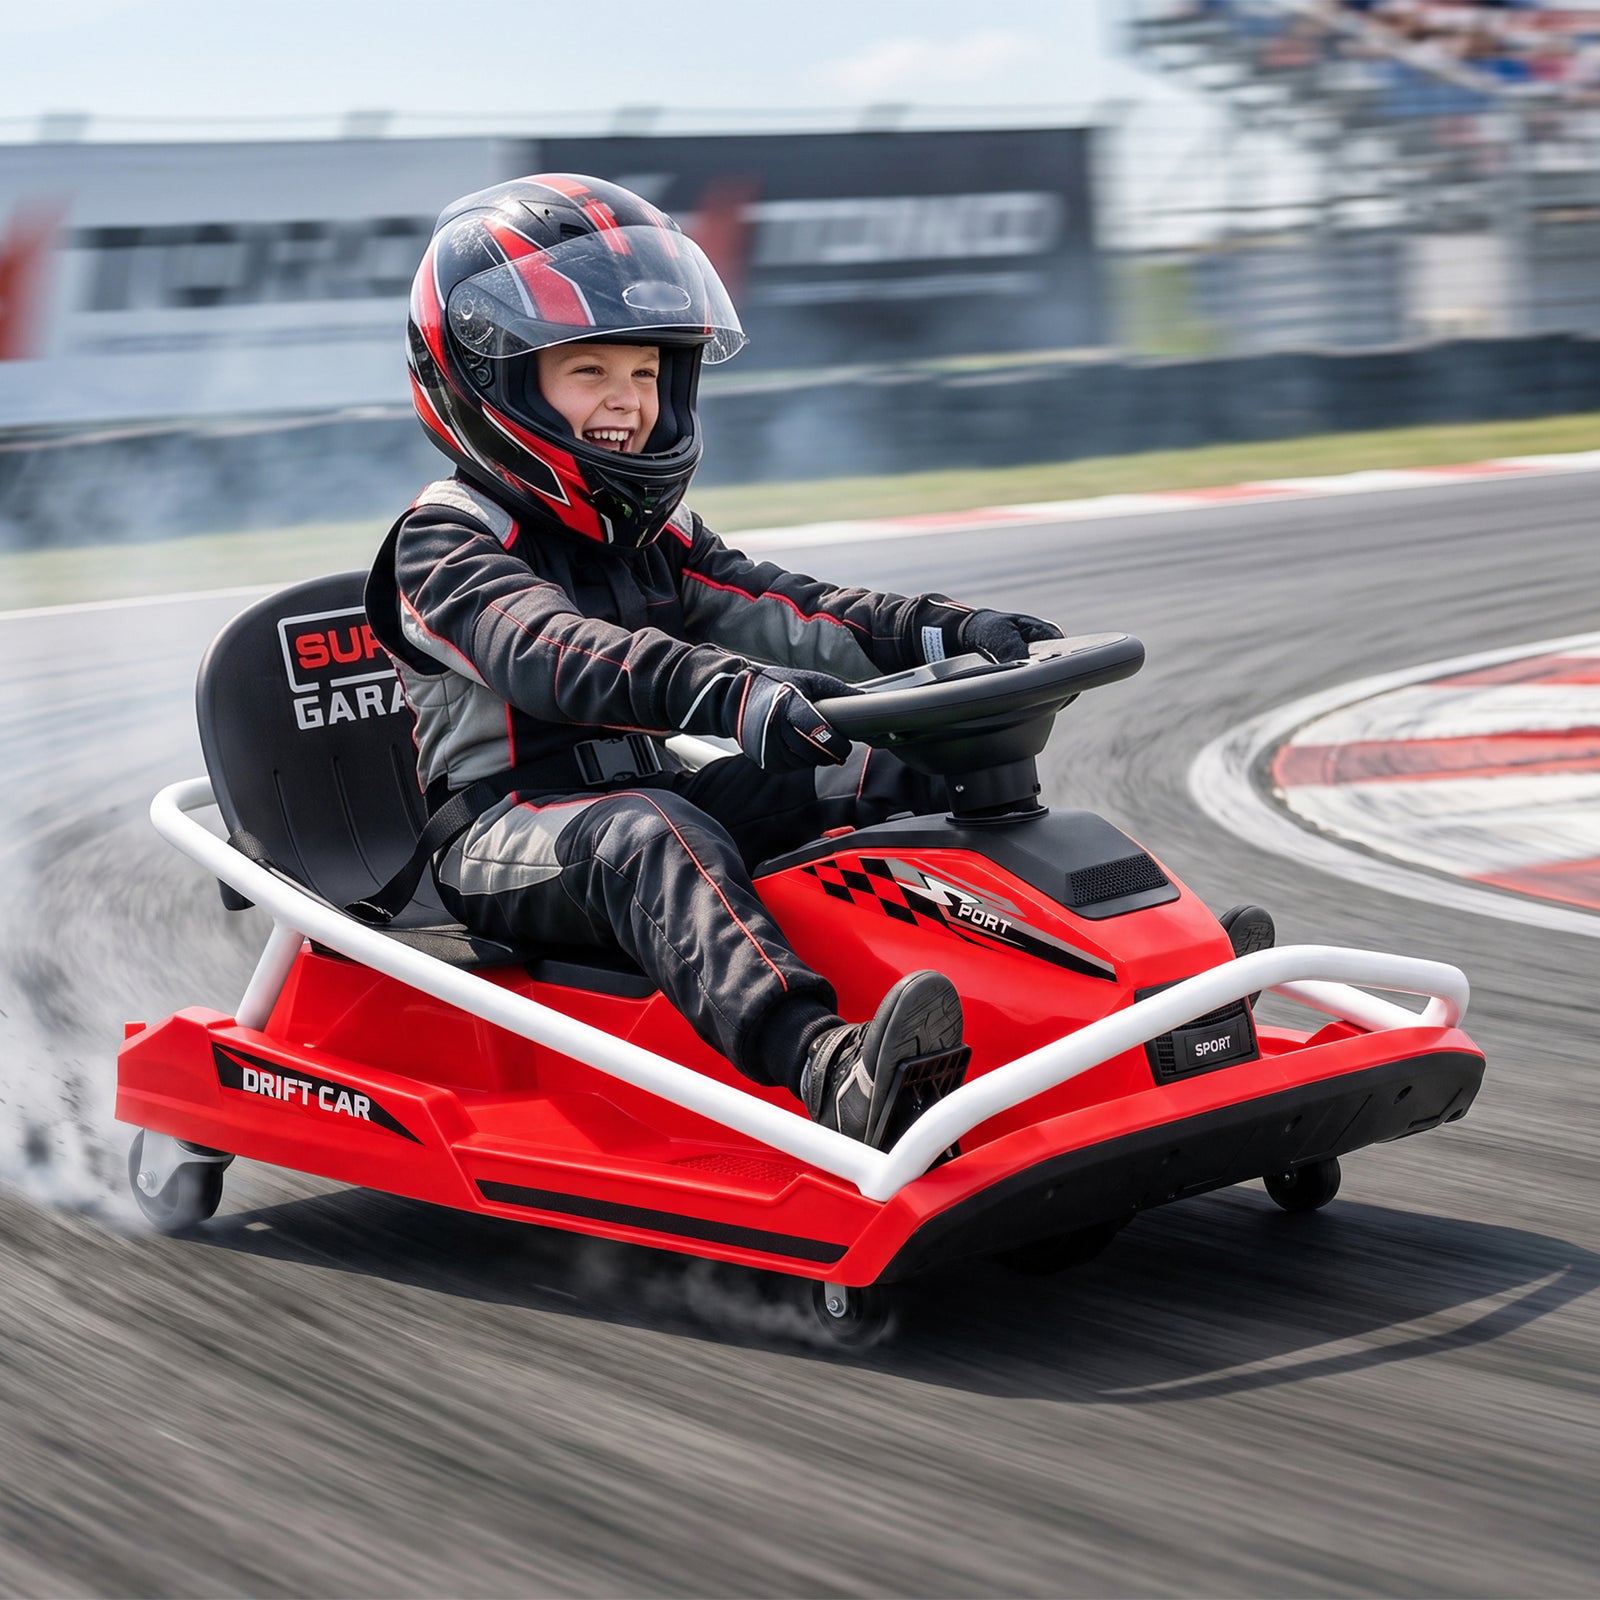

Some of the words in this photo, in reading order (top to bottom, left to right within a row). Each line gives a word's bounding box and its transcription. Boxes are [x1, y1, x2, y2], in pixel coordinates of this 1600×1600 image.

[1195, 1035, 1231, 1056] SPORT
[242, 1067, 313, 1106] DRIFT
[318, 1085, 371, 1122] CAR
